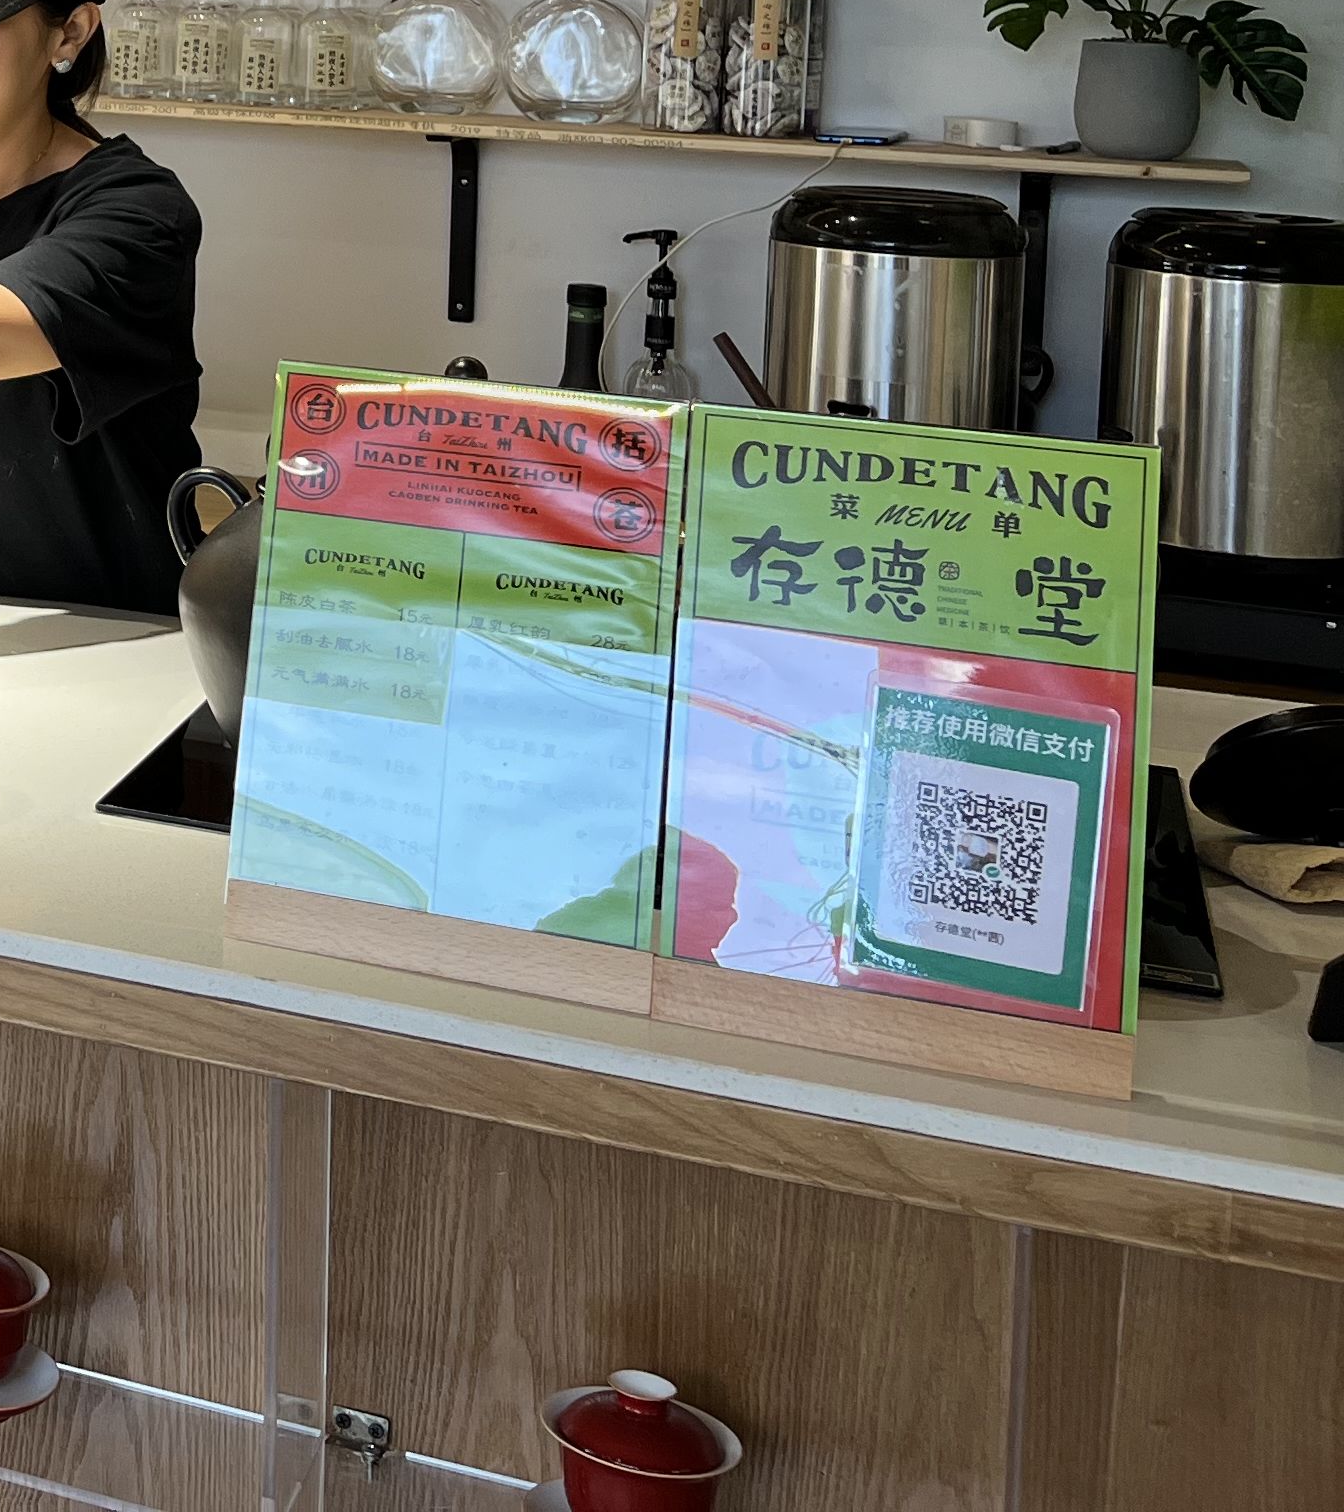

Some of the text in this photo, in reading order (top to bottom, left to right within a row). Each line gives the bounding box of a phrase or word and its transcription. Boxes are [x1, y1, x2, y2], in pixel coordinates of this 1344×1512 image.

[306, 394, 335, 422] 台
[356, 401, 587, 455] CUNDETANG
[417, 428, 432, 443] 台
[496, 438, 512, 452] 州
[611, 427, 650, 461] 括
[362, 448, 574, 486] MADE IN TAIZHOU
[731, 439, 1113, 529] CUNDETANG
[388, 490, 539, 516] CAOBEN DRINKING TEA
[456, 486, 521, 502] KUOCANG
[830, 492, 1022, 538] 菜 MENU 单
[304, 548, 426, 580] CUNDETANG
[495, 572, 625, 606] CUNDETANG
[730, 524, 1108, 647] 存德堂
[279, 590, 434, 627] 陈皮白茶 15元
[467, 615, 551, 640] 厚乳红韵
[393, 644, 431, 665] 18元
[391, 681, 429, 702] 18元
[884, 704, 1096, 763] 推荐使用微信支付
